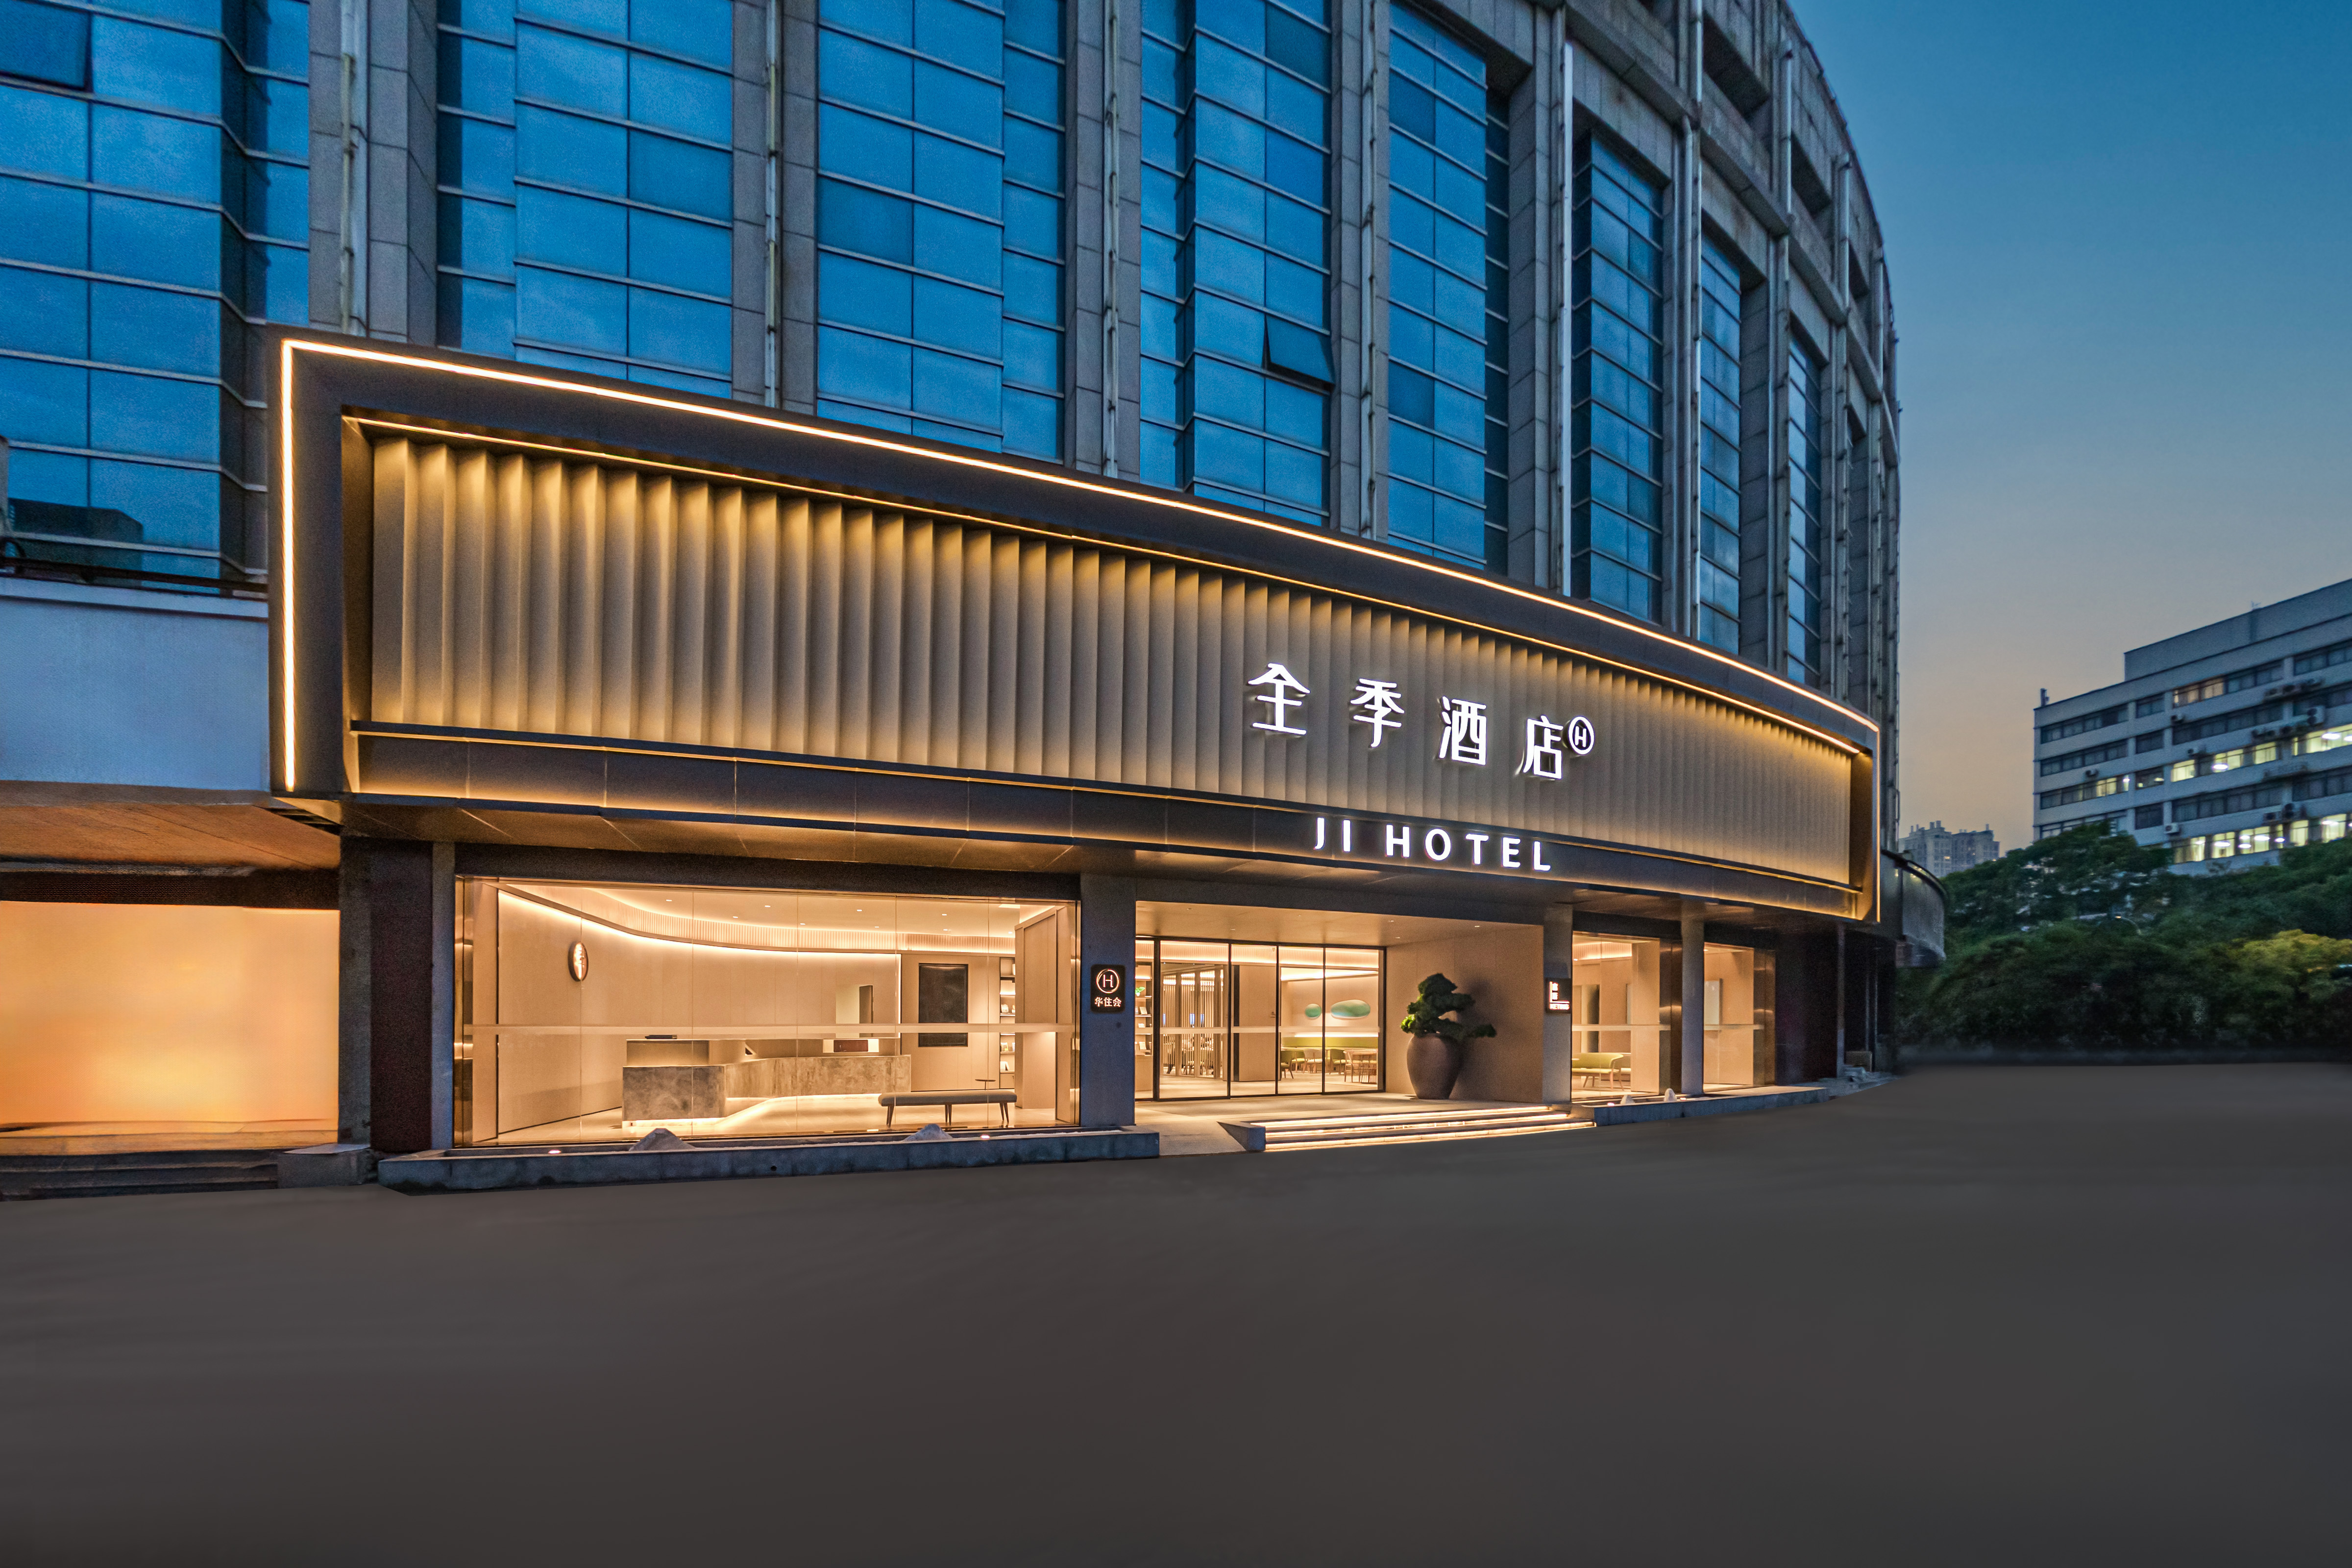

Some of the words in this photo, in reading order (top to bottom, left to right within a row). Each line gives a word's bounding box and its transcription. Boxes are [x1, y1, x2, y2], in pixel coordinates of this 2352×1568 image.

[1248, 662, 1564, 780] 全季酒店
[1314, 817, 1351, 852] JI
[1386, 824, 1551, 872] HOTEL
[1094, 996, 1122, 1007] 华住会
